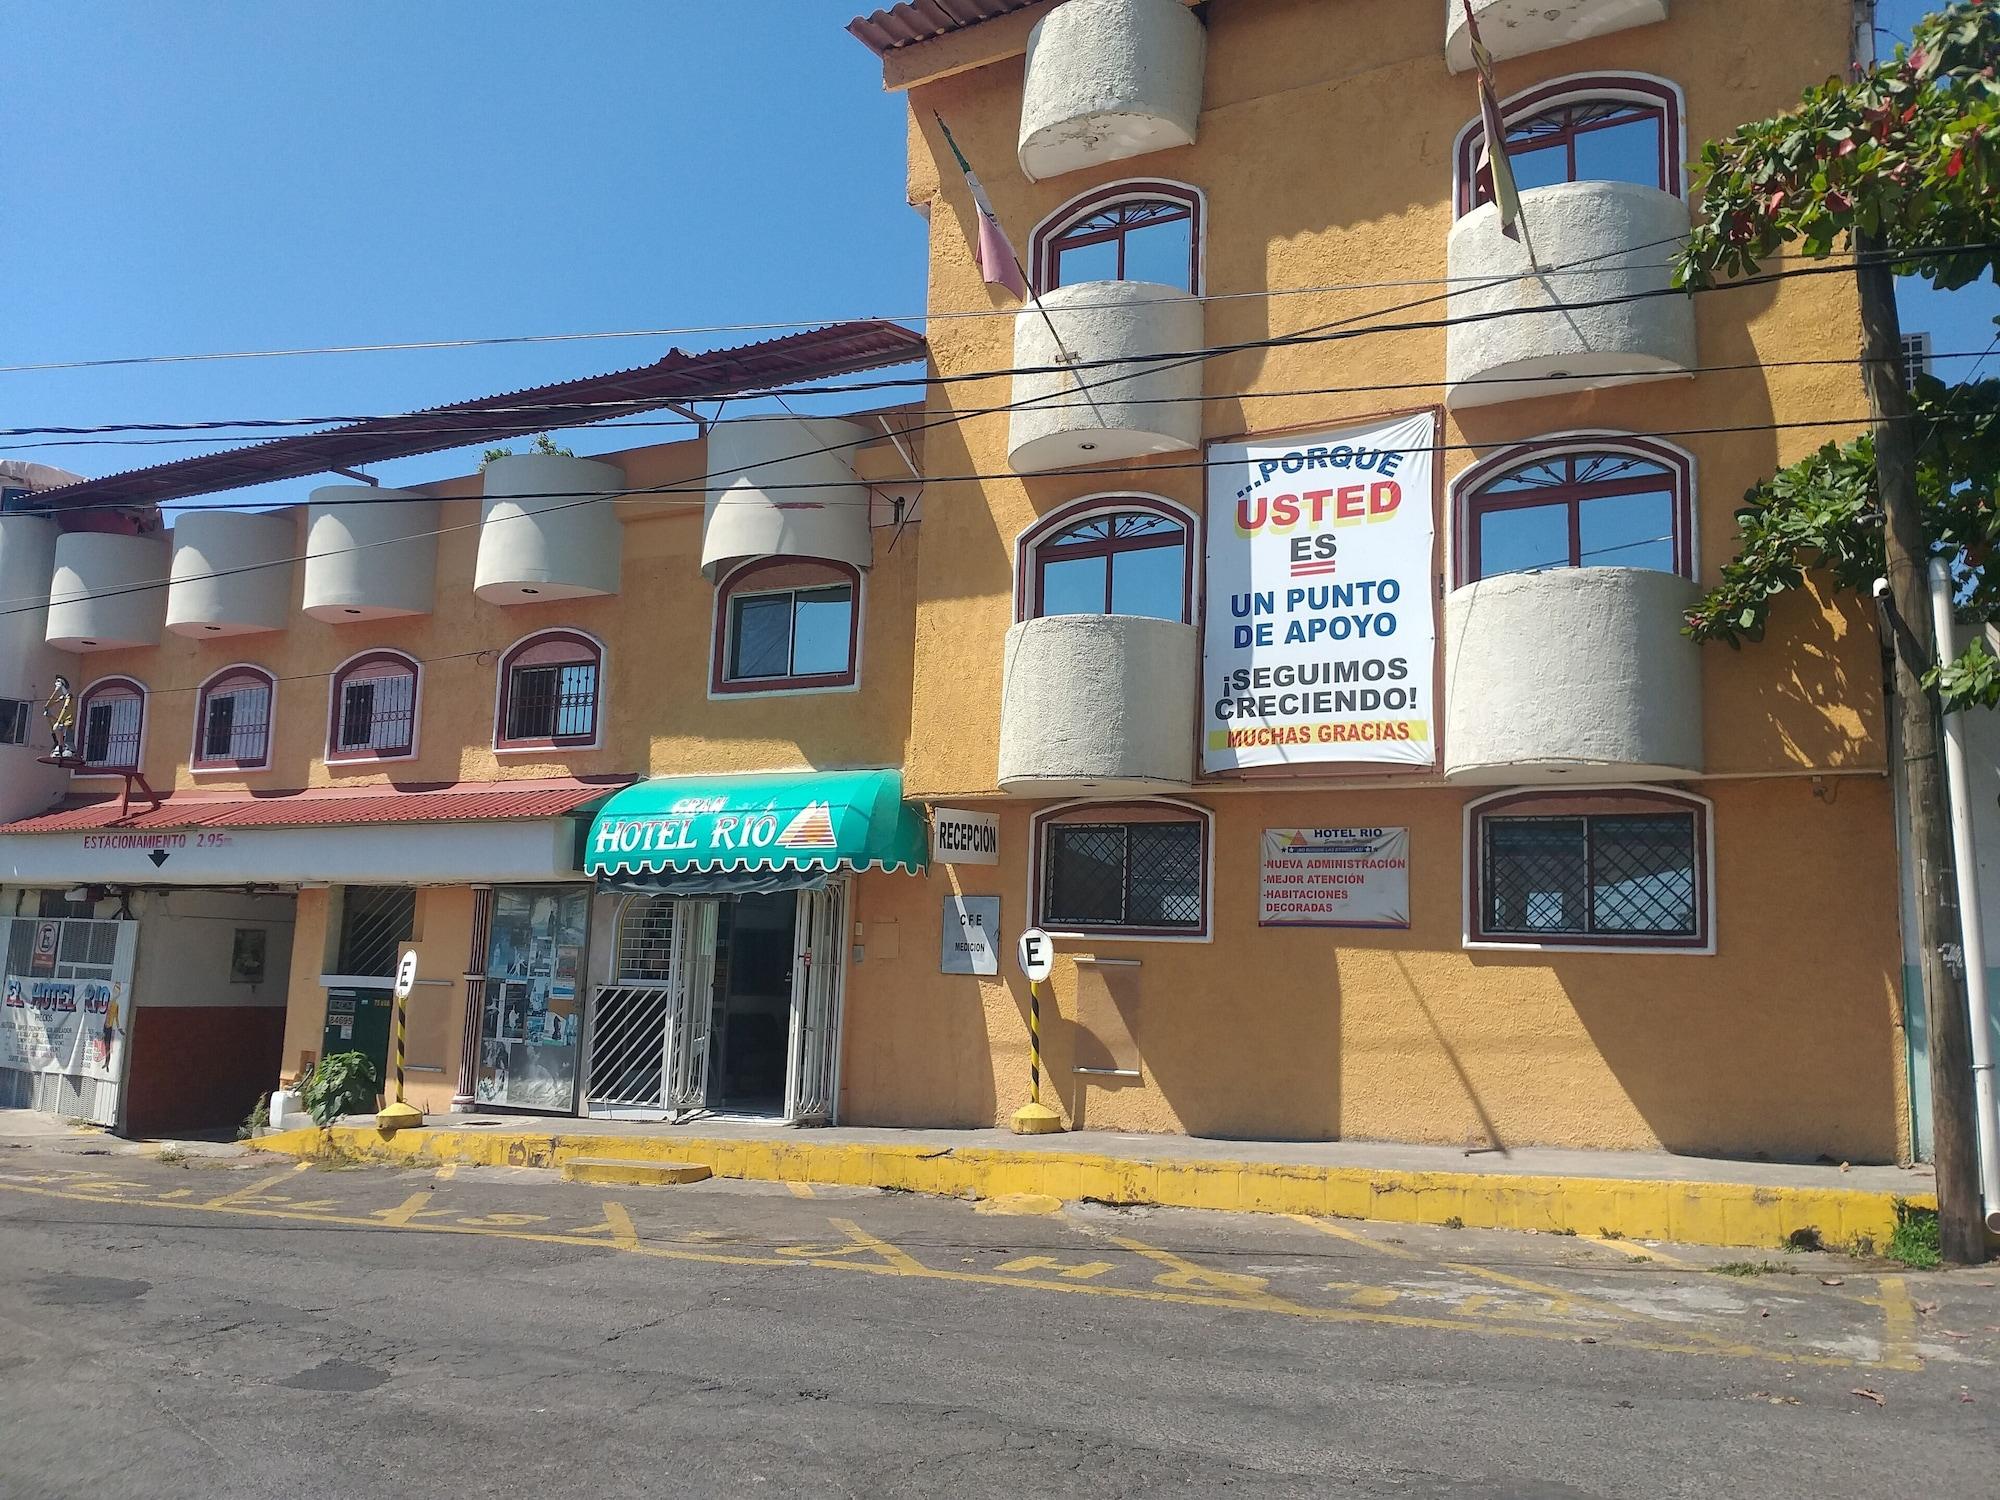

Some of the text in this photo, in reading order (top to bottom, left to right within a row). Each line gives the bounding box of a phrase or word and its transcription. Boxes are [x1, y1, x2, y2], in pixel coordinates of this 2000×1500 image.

[1236, 480, 1402, 533] USTED
[1290, 533, 1337, 562] ES
[1231, 579, 1400, 618] UN PUNTO
[1234, 612, 1397, 649] DE APOYO
[1223, 658, 1408, 697] ¡SEGUIMOS
[1215, 687, 1417, 720] CRECIENDO!
[1227, 722, 1410, 748] MUCHAS GRACIAS
[84, 834, 186, 849] ESTACIONAMIENTO
[595, 817, 698, 852] HOTEL
[939, 818, 996, 853] RECEPCIÓN
[1314, 828, 1382, 838] HOTEL RIO
[1263, 873, 1365, 884] -MEJOR ATENCIÓN
[1263, 890, 1348, 899] -HABITACIONES
[1266, 903, 1333, 913] DECORADAS
[1025, 937, 1044, 966] E
[399, 961, 411, 986] E
[30, 982, 77, 1012] HOTEL
[84, 983, 111, 1014] RIO
